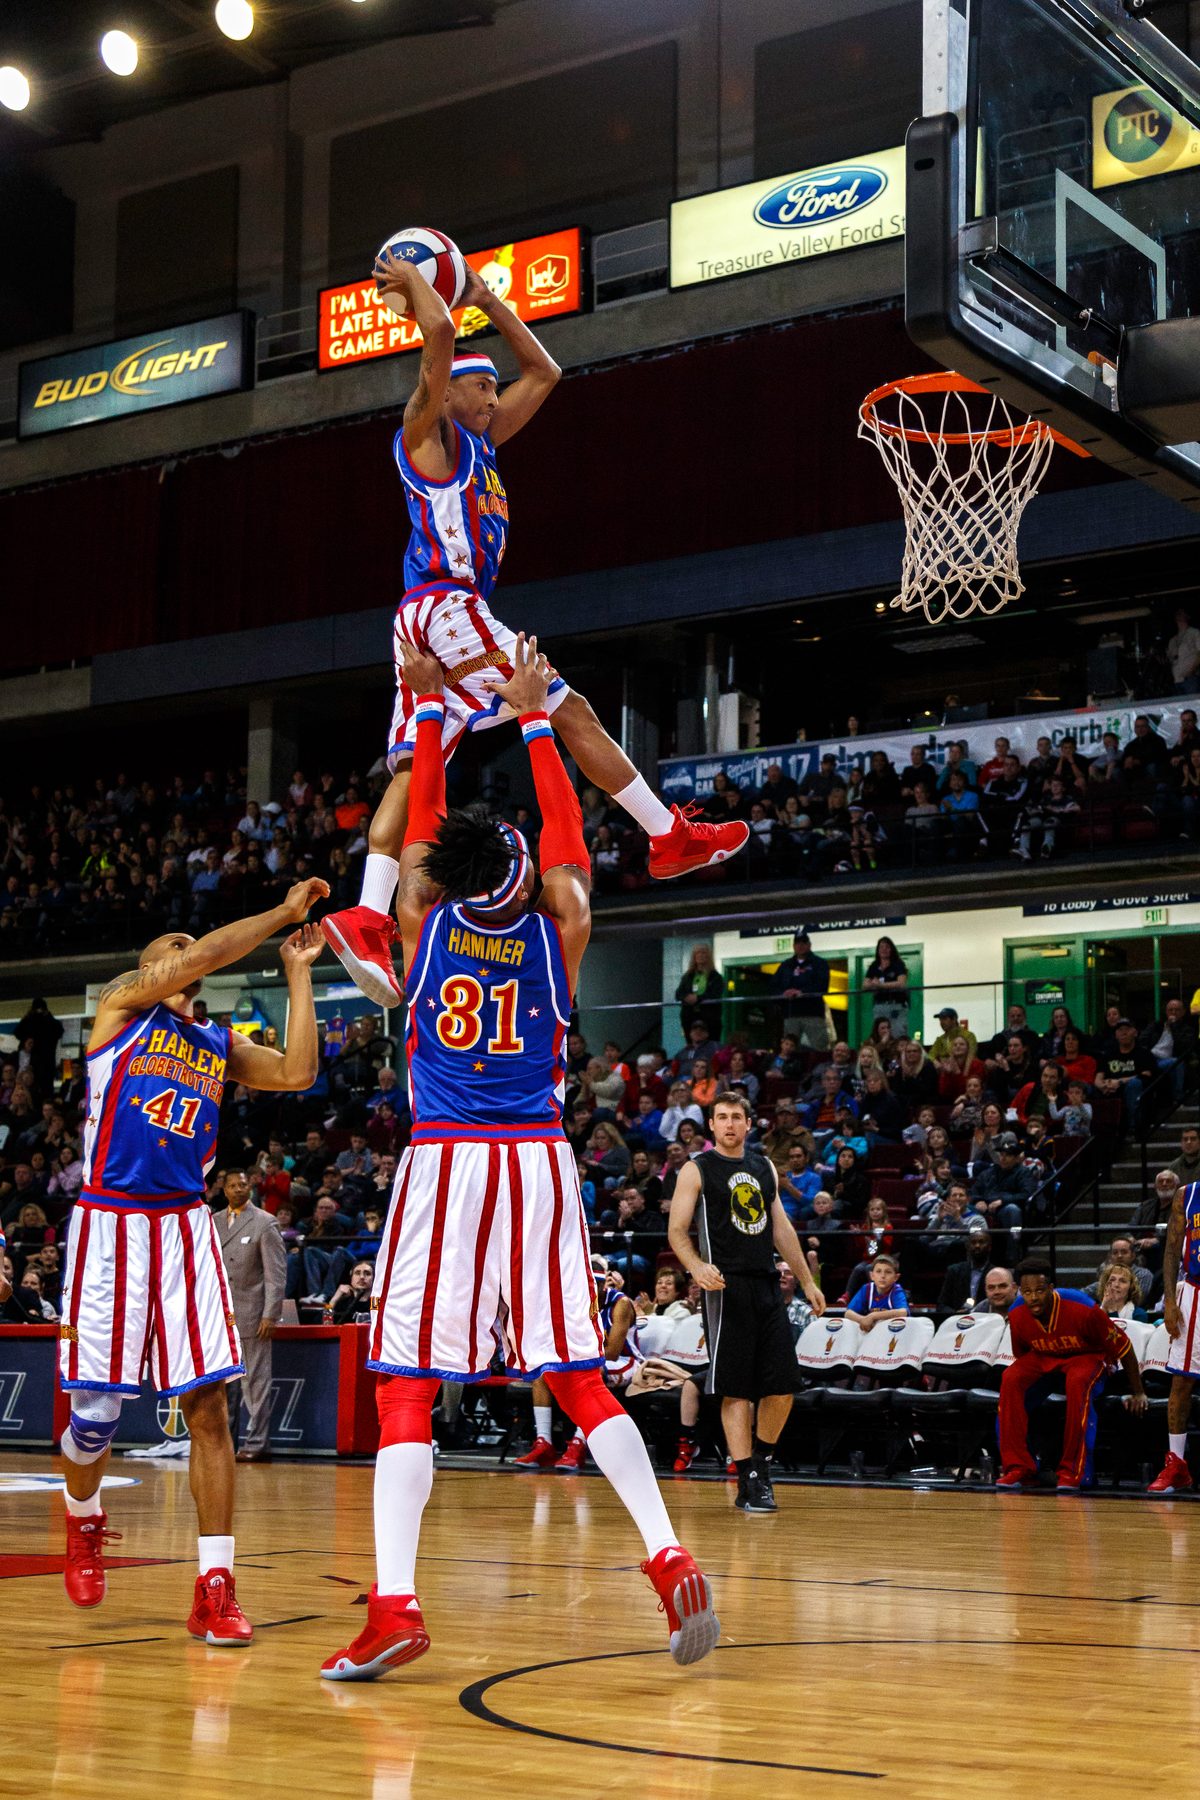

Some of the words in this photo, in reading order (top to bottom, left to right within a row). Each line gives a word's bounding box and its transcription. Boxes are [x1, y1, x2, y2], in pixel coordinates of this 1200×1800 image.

[1116, 109, 1160, 145] PTC
[778, 175, 862, 222] Ford
[697, 248, 774, 279] Treasure
[778, 234, 835, 260] Valley
[840, 218, 883, 245] Ford
[890, 214, 906, 234] St
[529, 259, 567, 293] Jack
[360, 286, 384, 306] YO
[329, 332, 385, 361] GAME
[389, 323, 424, 347] PLA
[330, 312, 375, 338] LATE
[33, 371, 109, 408] BUD
[122, 341, 228, 386] LIGHT
[788, 753, 811, 786] 17
[1145, 908, 1163, 921] EXIT
[448, 927, 526, 966] HAMMER
[436, 974, 524, 1054] 31
[147, 1029, 227, 1083] HARLEM
[129, 1054, 225, 1109] GLOBETROTTER
[142, 1088, 202, 1139] 41
[727, 1171, 761, 1191] WORLD
[731, 1212, 750, 1235] ALL
[1031, 1335, 1081, 1351] HARLEM
